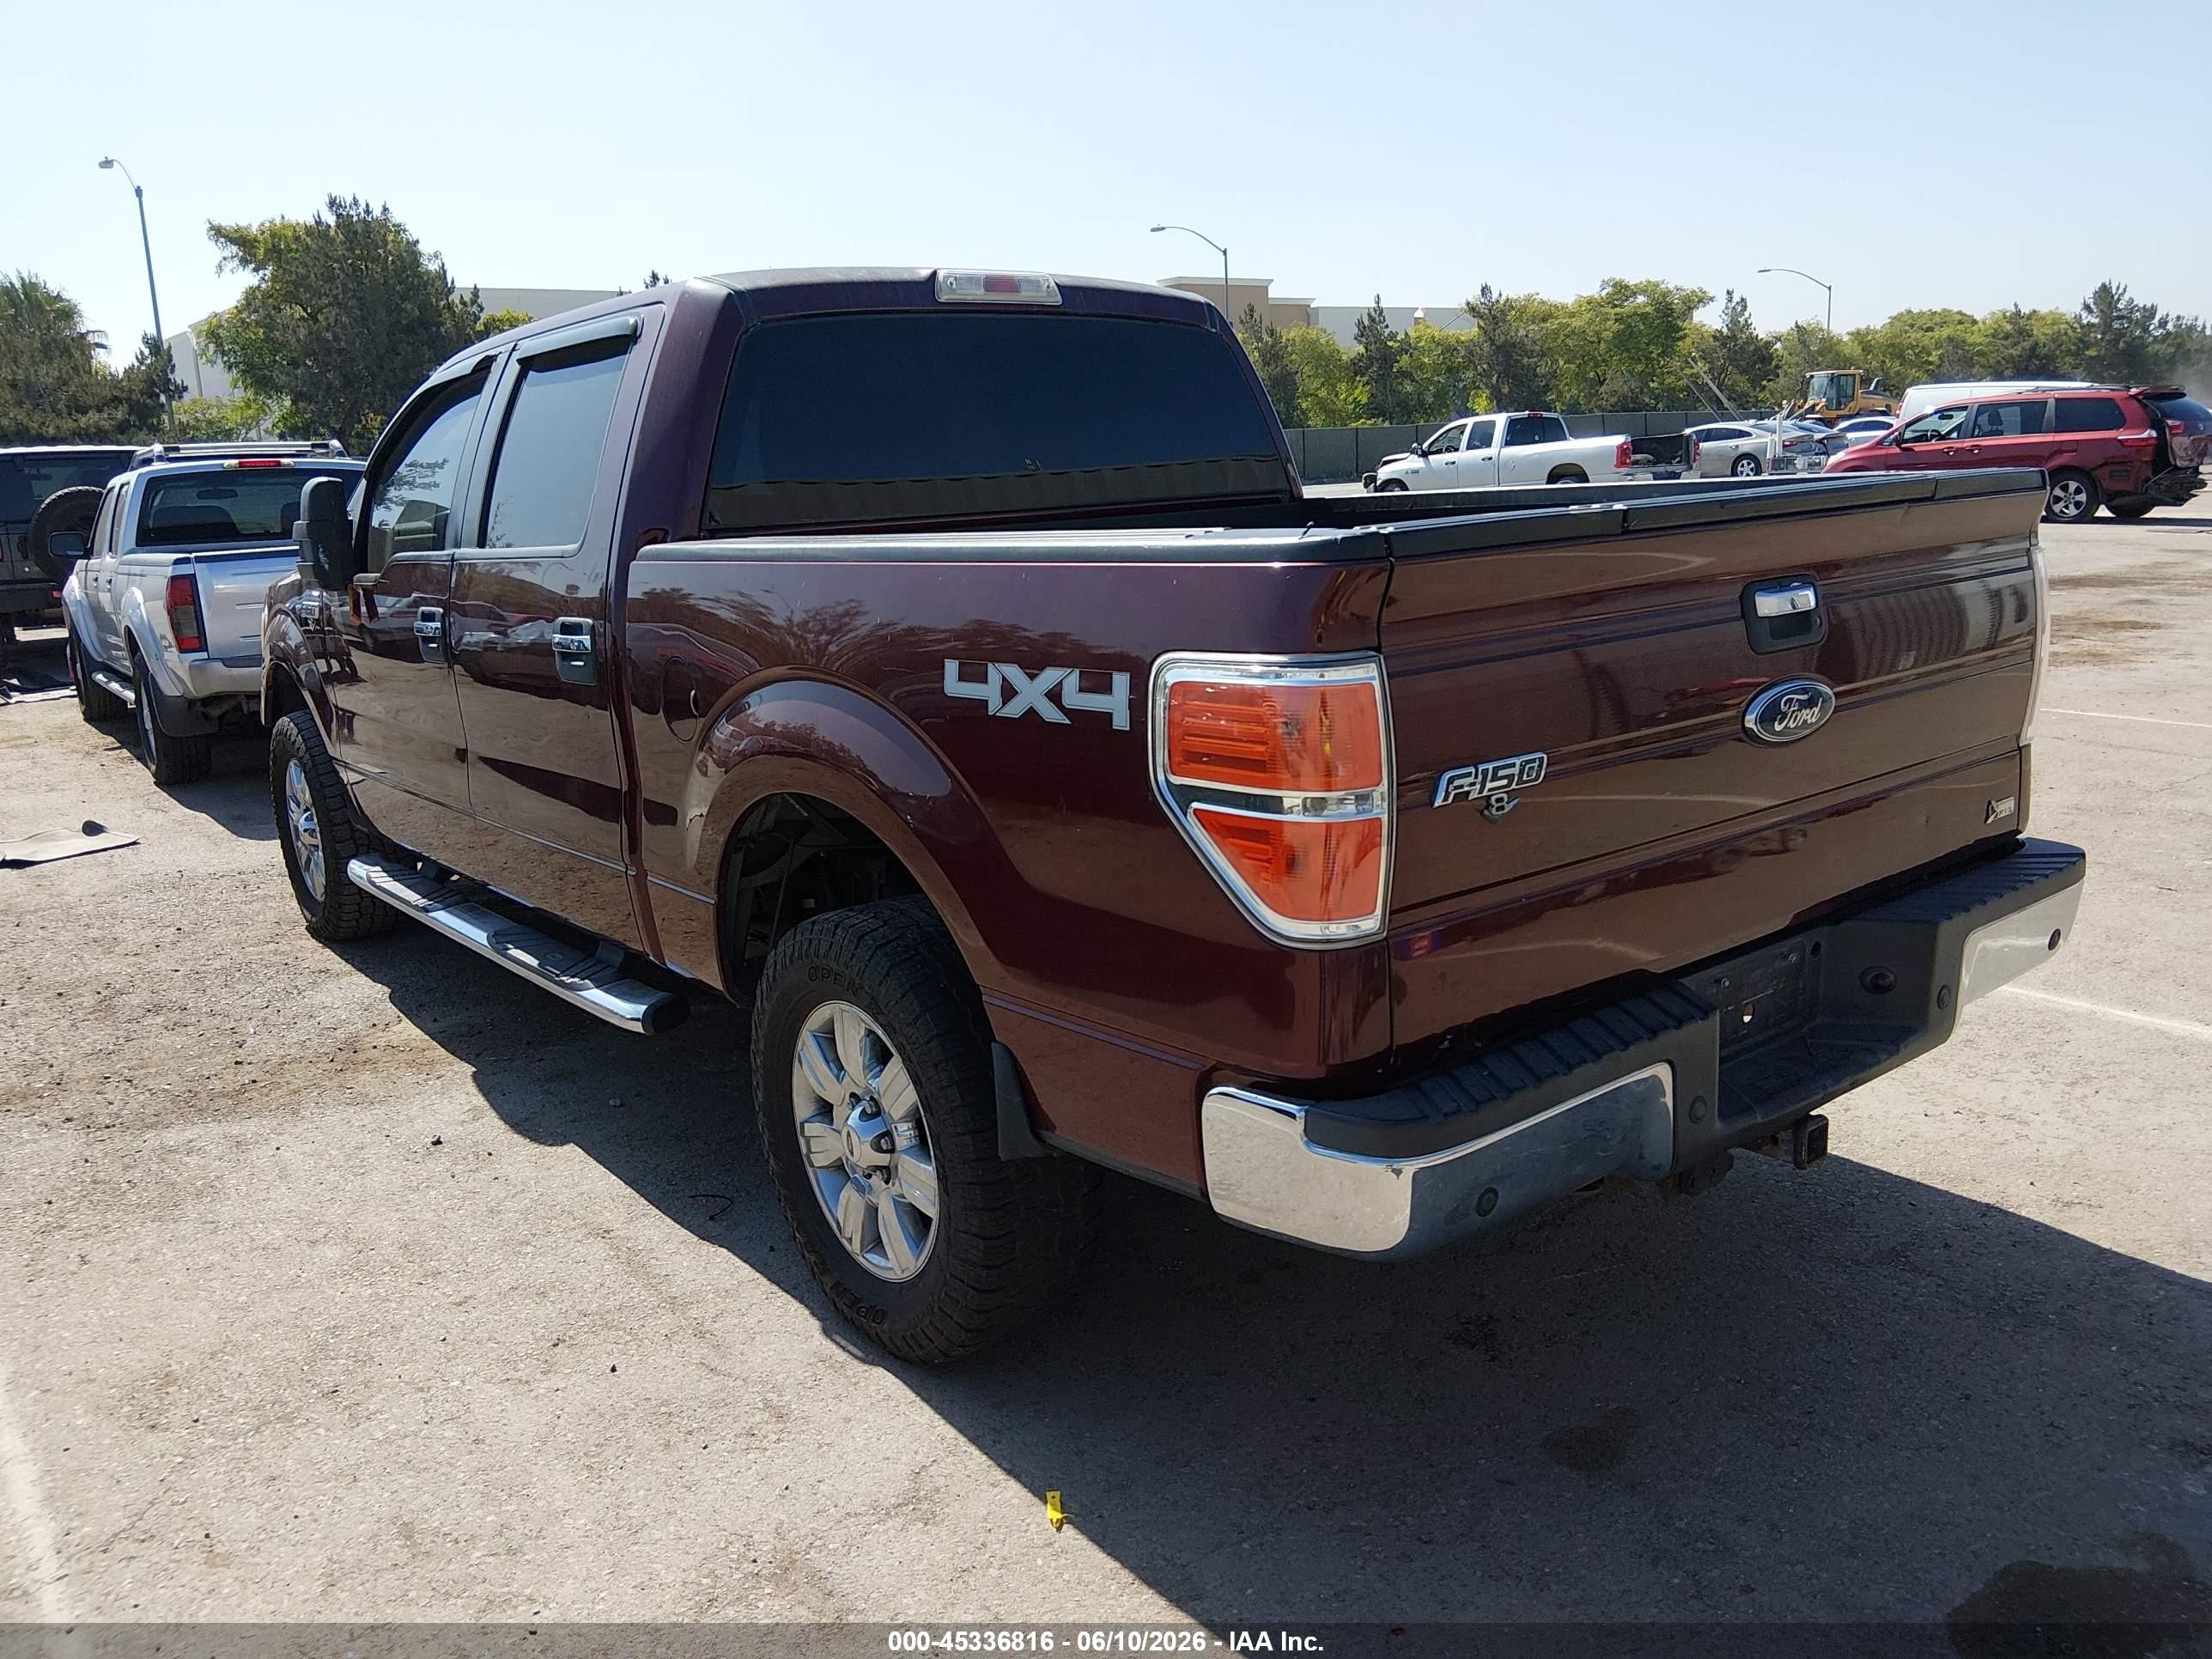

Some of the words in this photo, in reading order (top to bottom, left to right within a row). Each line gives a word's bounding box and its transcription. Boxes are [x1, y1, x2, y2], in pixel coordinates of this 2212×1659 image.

[944, 659, 1131, 731] 4X4
[1774, 692, 1822, 732] Ford
[1432, 752, 1547, 808] F-150
[808, 965, 860, 996] OPEN
